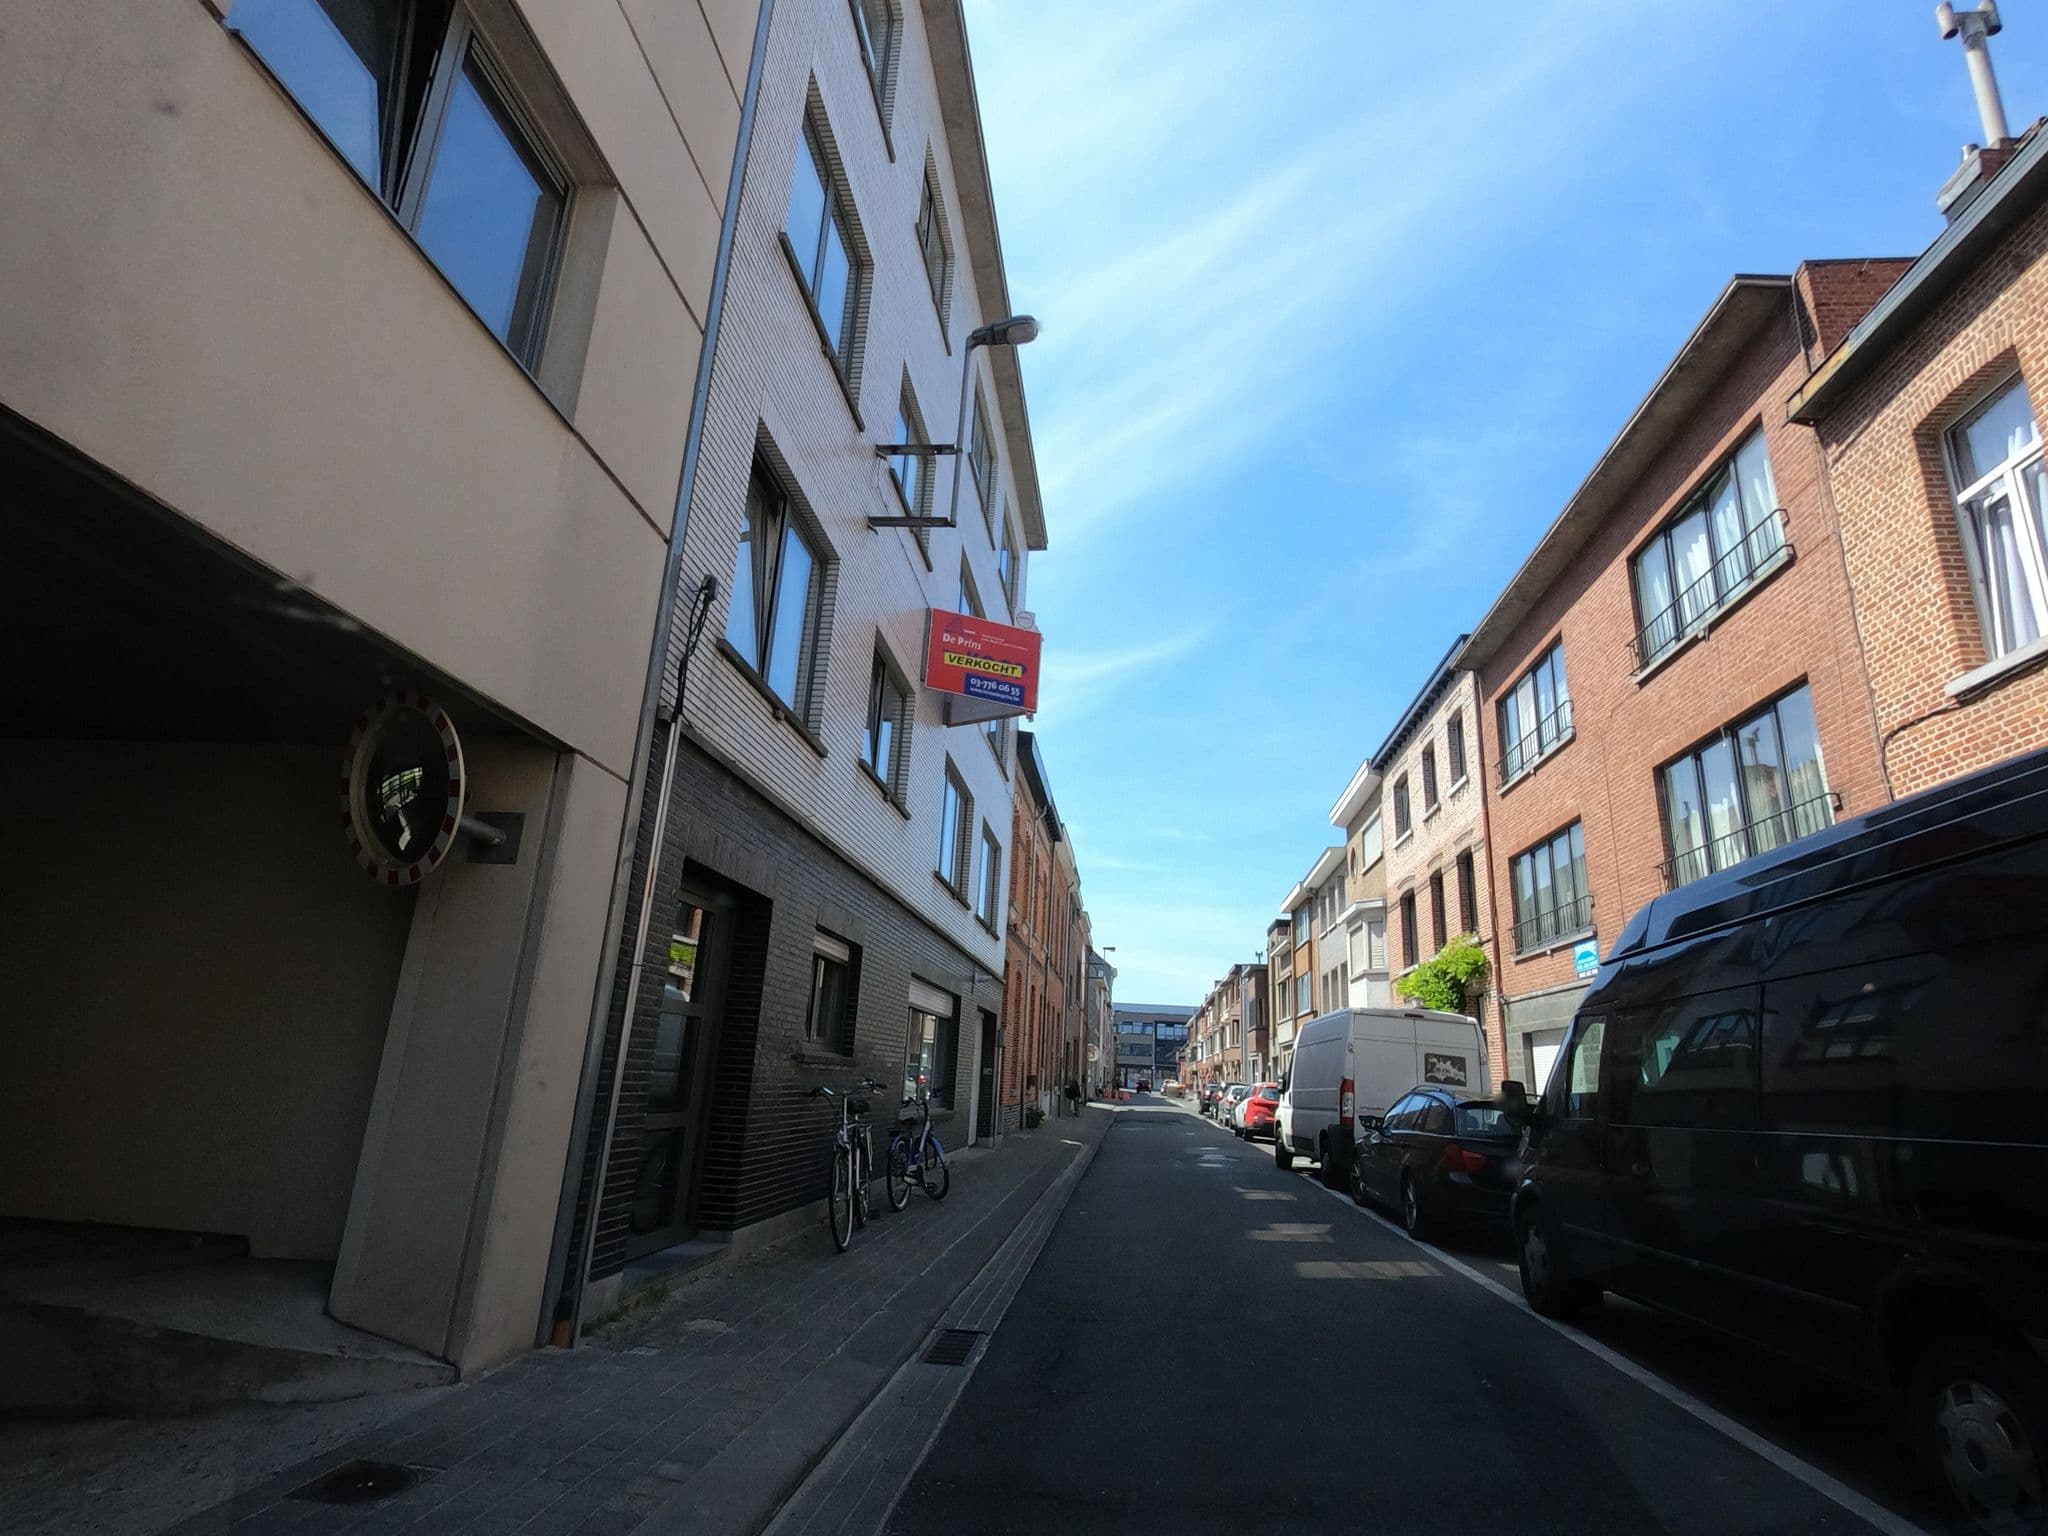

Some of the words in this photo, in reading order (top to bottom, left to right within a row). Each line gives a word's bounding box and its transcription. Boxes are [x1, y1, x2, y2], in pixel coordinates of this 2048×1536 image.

[942, 633, 956, 645] De
[957, 637, 982, 650] Prins
[948, 654, 1018, 675] VERKOCHT
[998, 684, 1009, 692] 06
[1010, 687, 1020, 696] 55
